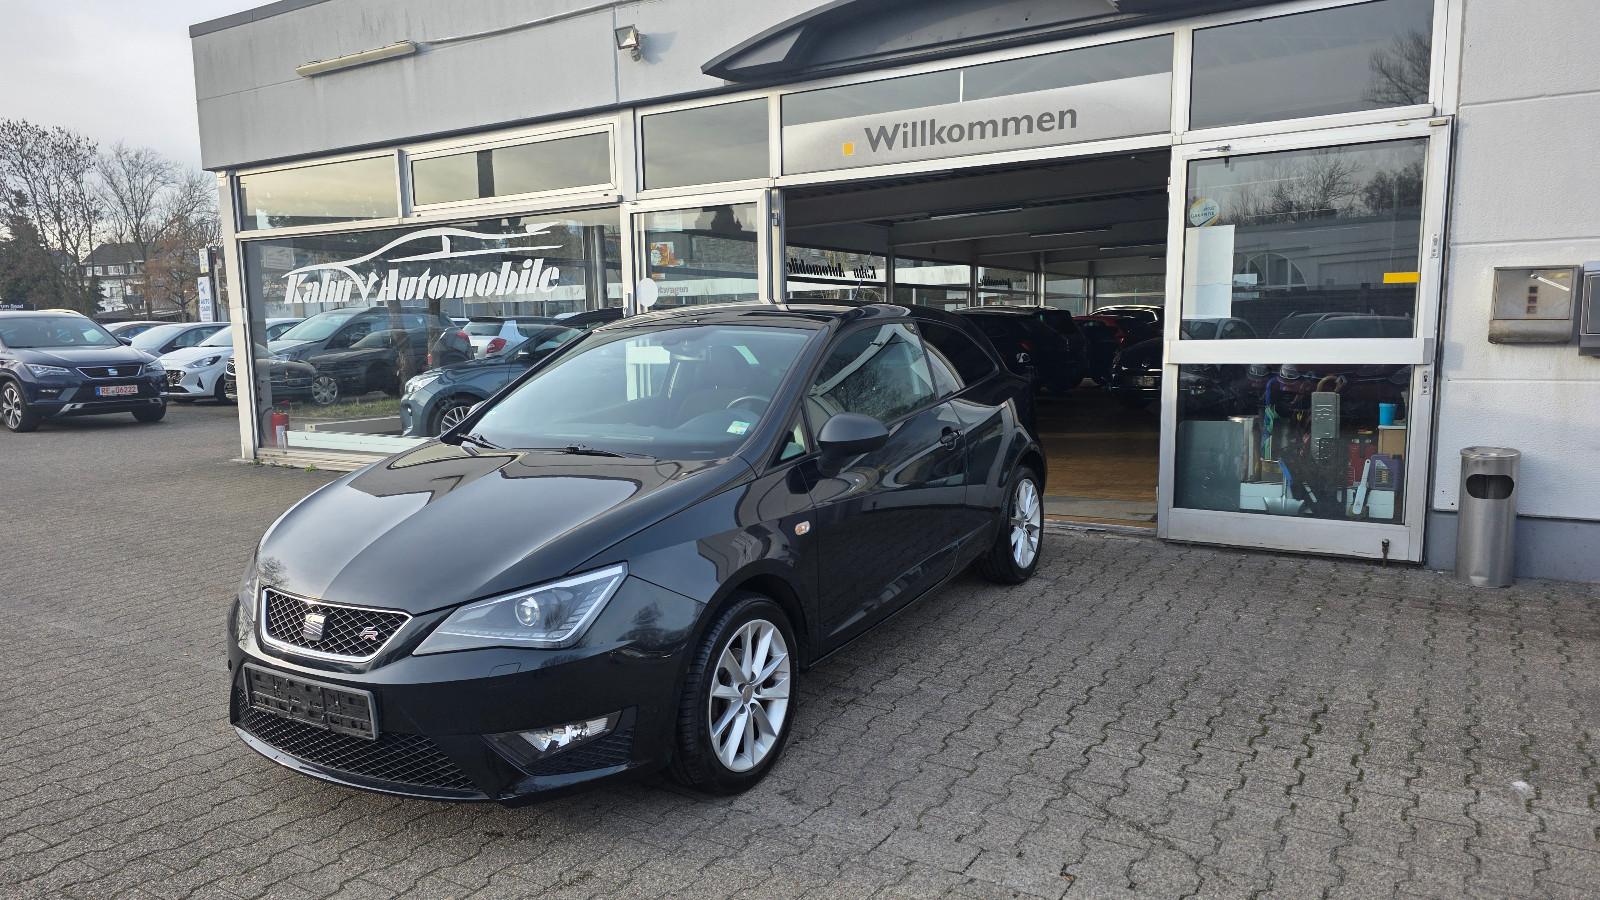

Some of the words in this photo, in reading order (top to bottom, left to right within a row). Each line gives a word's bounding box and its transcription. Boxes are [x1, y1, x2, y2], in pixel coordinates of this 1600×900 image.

[864, 108, 1077, 152] Willkommen
[284, 272, 353, 304] Kahn
[376, 257, 560, 301] Automobile
